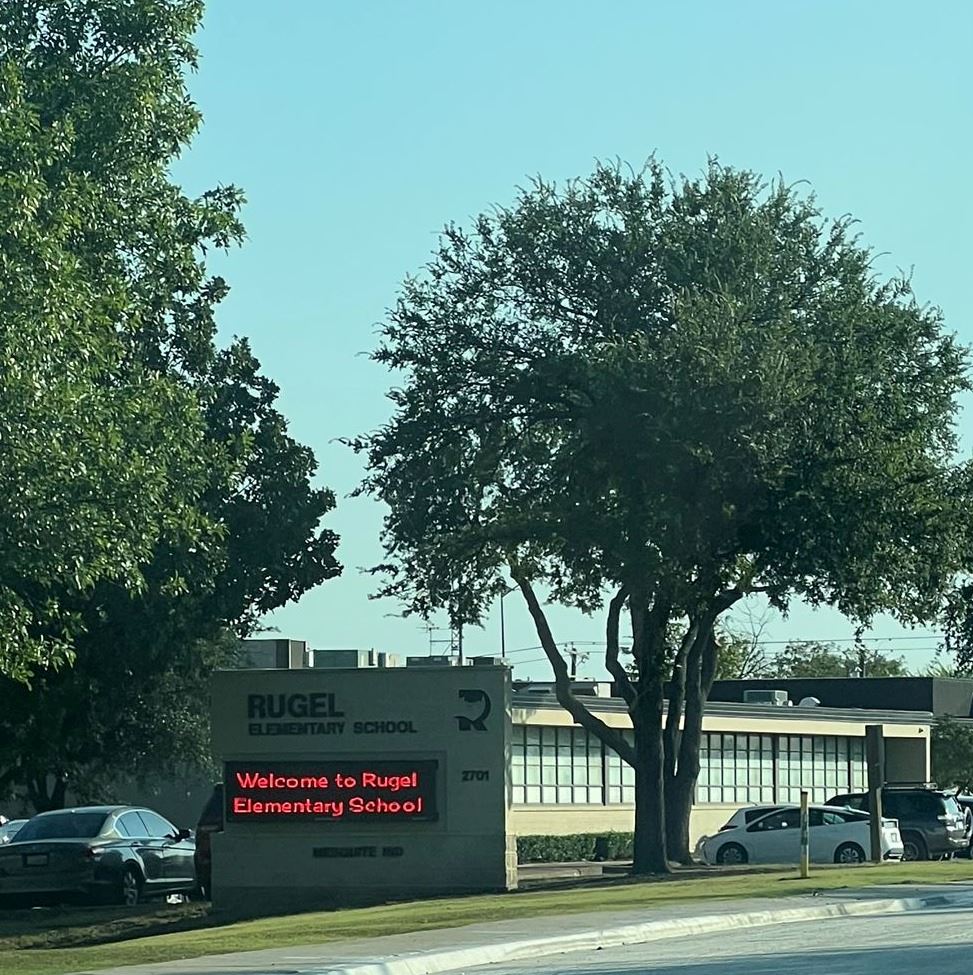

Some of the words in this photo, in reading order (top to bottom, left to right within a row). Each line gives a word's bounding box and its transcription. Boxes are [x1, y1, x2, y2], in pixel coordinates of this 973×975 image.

[248, 693, 344, 718] RUGEL
[249, 722, 345, 736] ELEMENTARY
[353, 721, 417, 734] SCHOOL
[236, 772, 328, 789] Welcome
[335, 773, 356, 788] to
[362, 772, 417, 791] Rugel
[461, 770, 490, 782] 2701
[233, 798, 344, 816] Elementary
[349, 797, 422, 813] School
